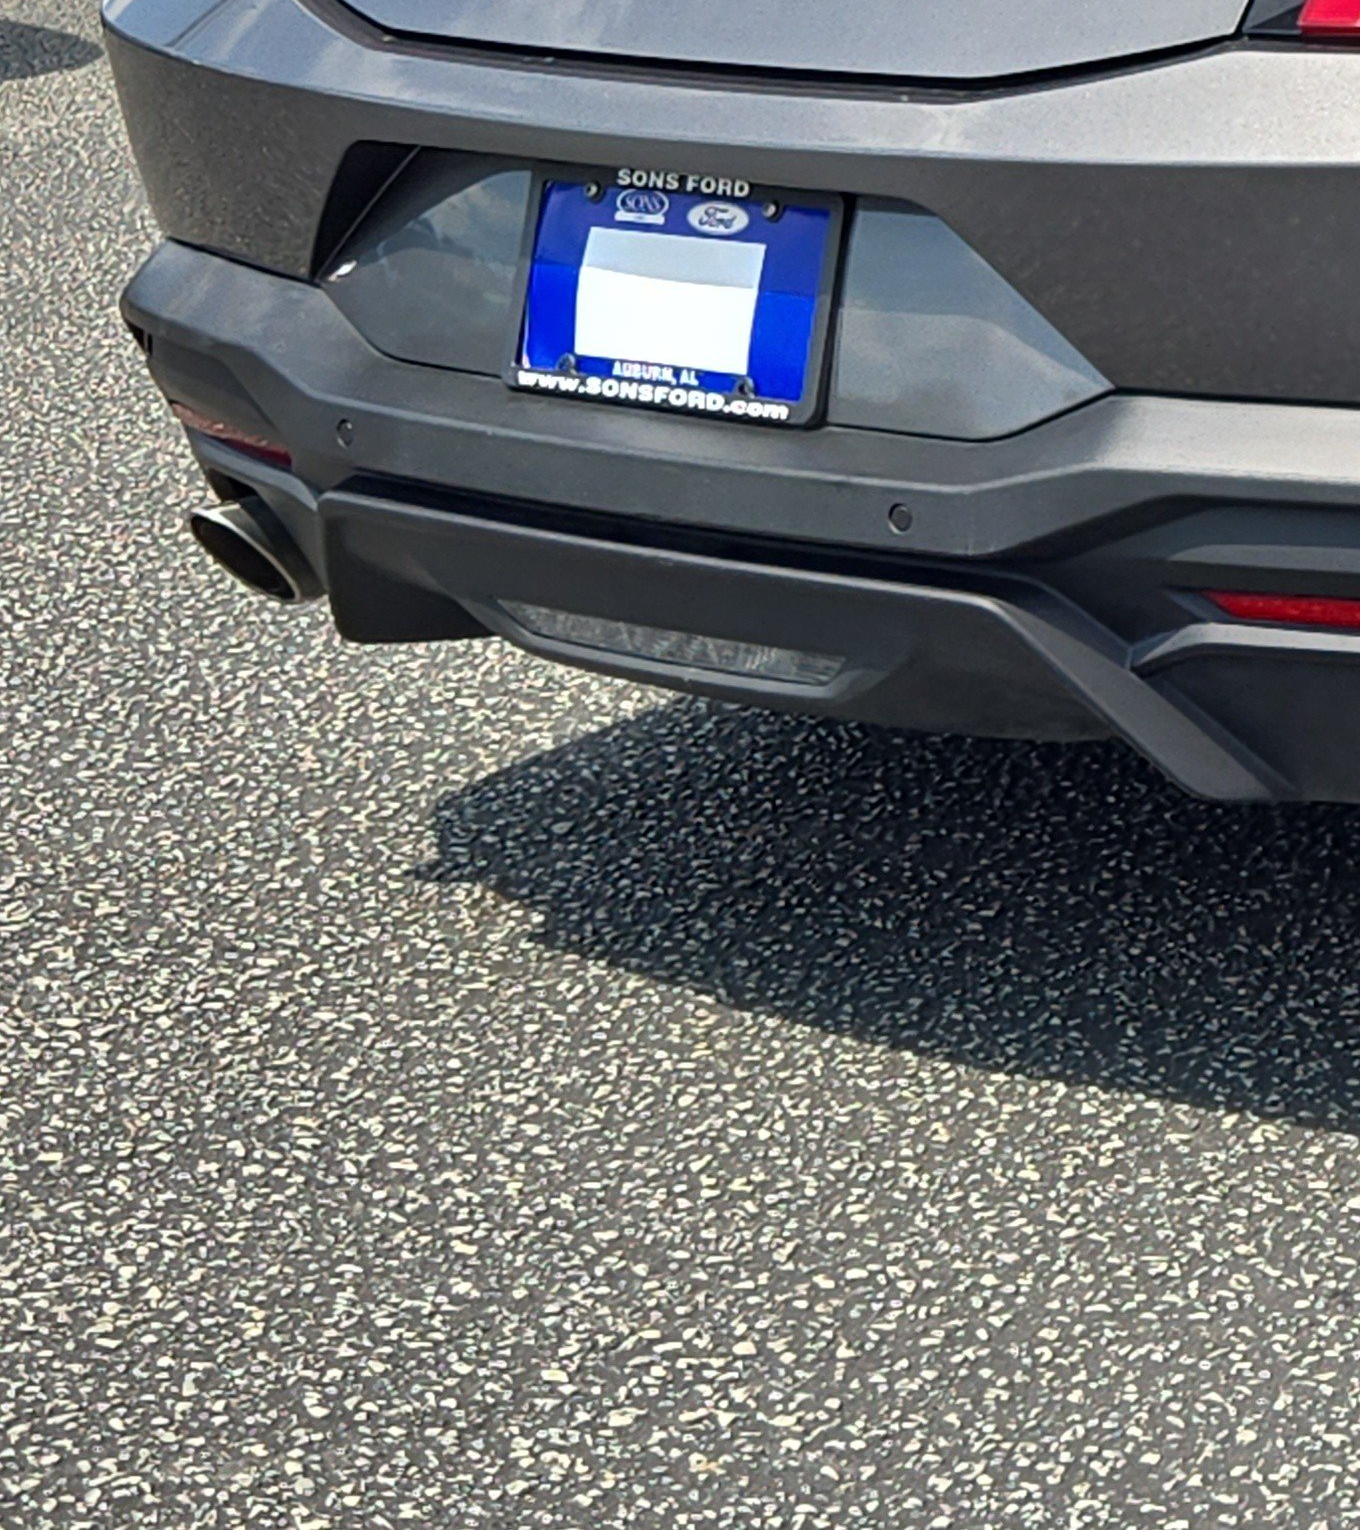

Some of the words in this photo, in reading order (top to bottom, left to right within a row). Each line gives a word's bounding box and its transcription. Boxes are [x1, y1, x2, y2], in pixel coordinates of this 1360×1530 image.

[616, 167, 681, 190] SONS
[685, 174, 750, 198] FORD
[698, 205, 738, 230] Ford
[679, 368, 699, 386] AL
[517, 369, 790, 420] www.SONSFORD.com
